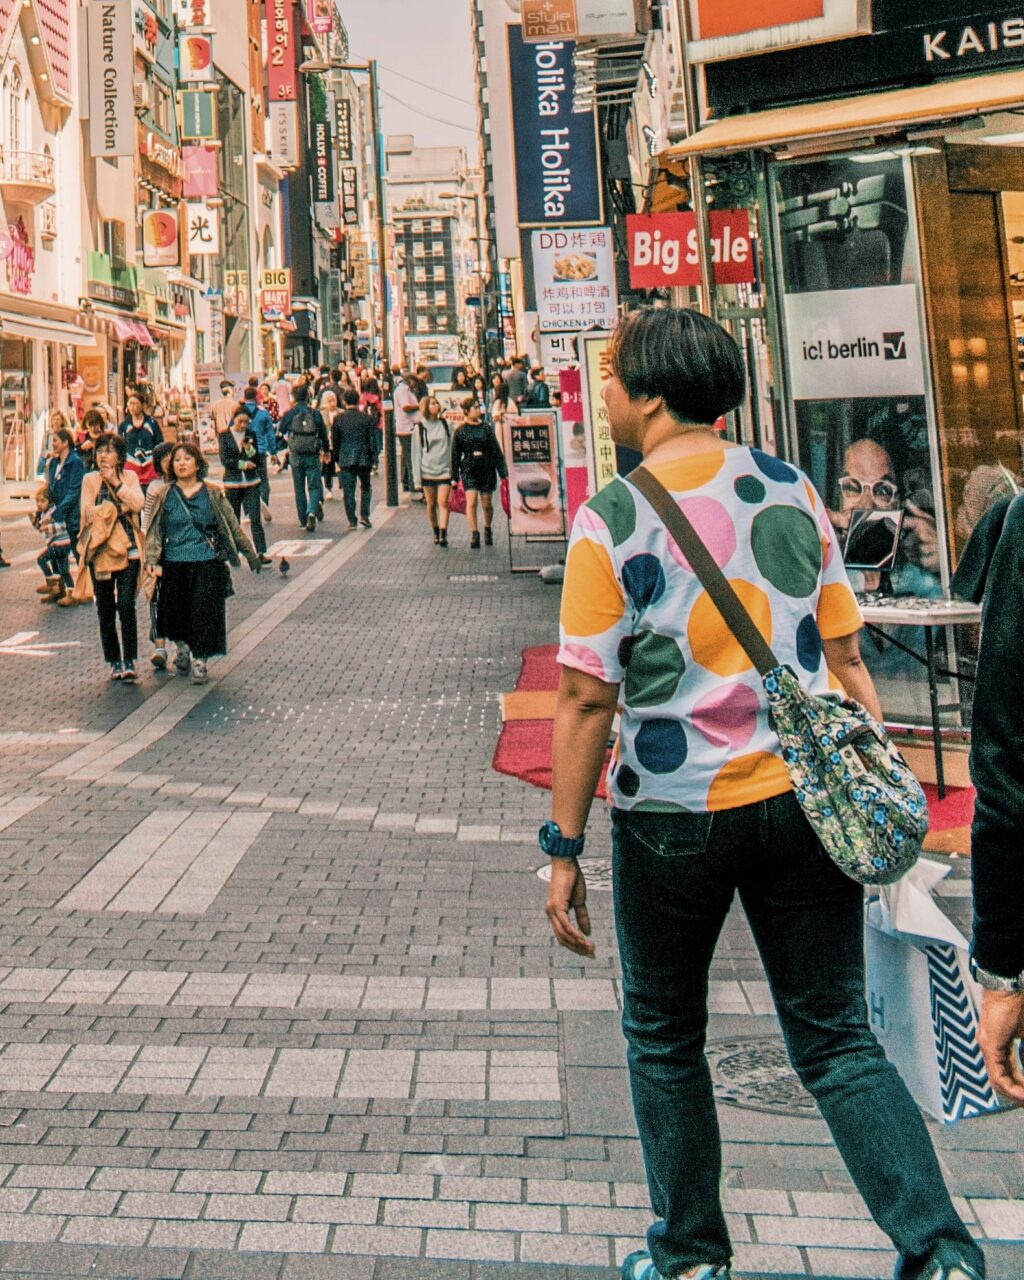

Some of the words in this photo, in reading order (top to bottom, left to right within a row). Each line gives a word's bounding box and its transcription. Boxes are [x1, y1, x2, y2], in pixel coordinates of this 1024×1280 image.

[527, 10, 571, 25] style
[528, 22, 573, 36] mall
[102, 4, 116, 62] Nature
[272, 46, 284, 66] 2
[103, 68, 118, 150] Collection
[316, 123, 326, 157] HOLLYS
[318, 167, 327, 199] COFFEE
[541, 127, 572, 218] Holika
[190, 216, 213, 243] 光
[540, 233, 568, 250] DD
[634, 231, 680, 275] Big
[265, 272, 286, 285] BIG
[264, 291, 287, 306] MART
[803, 342, 824, 362] ic!
[828, 338, 879, 360] berlin
